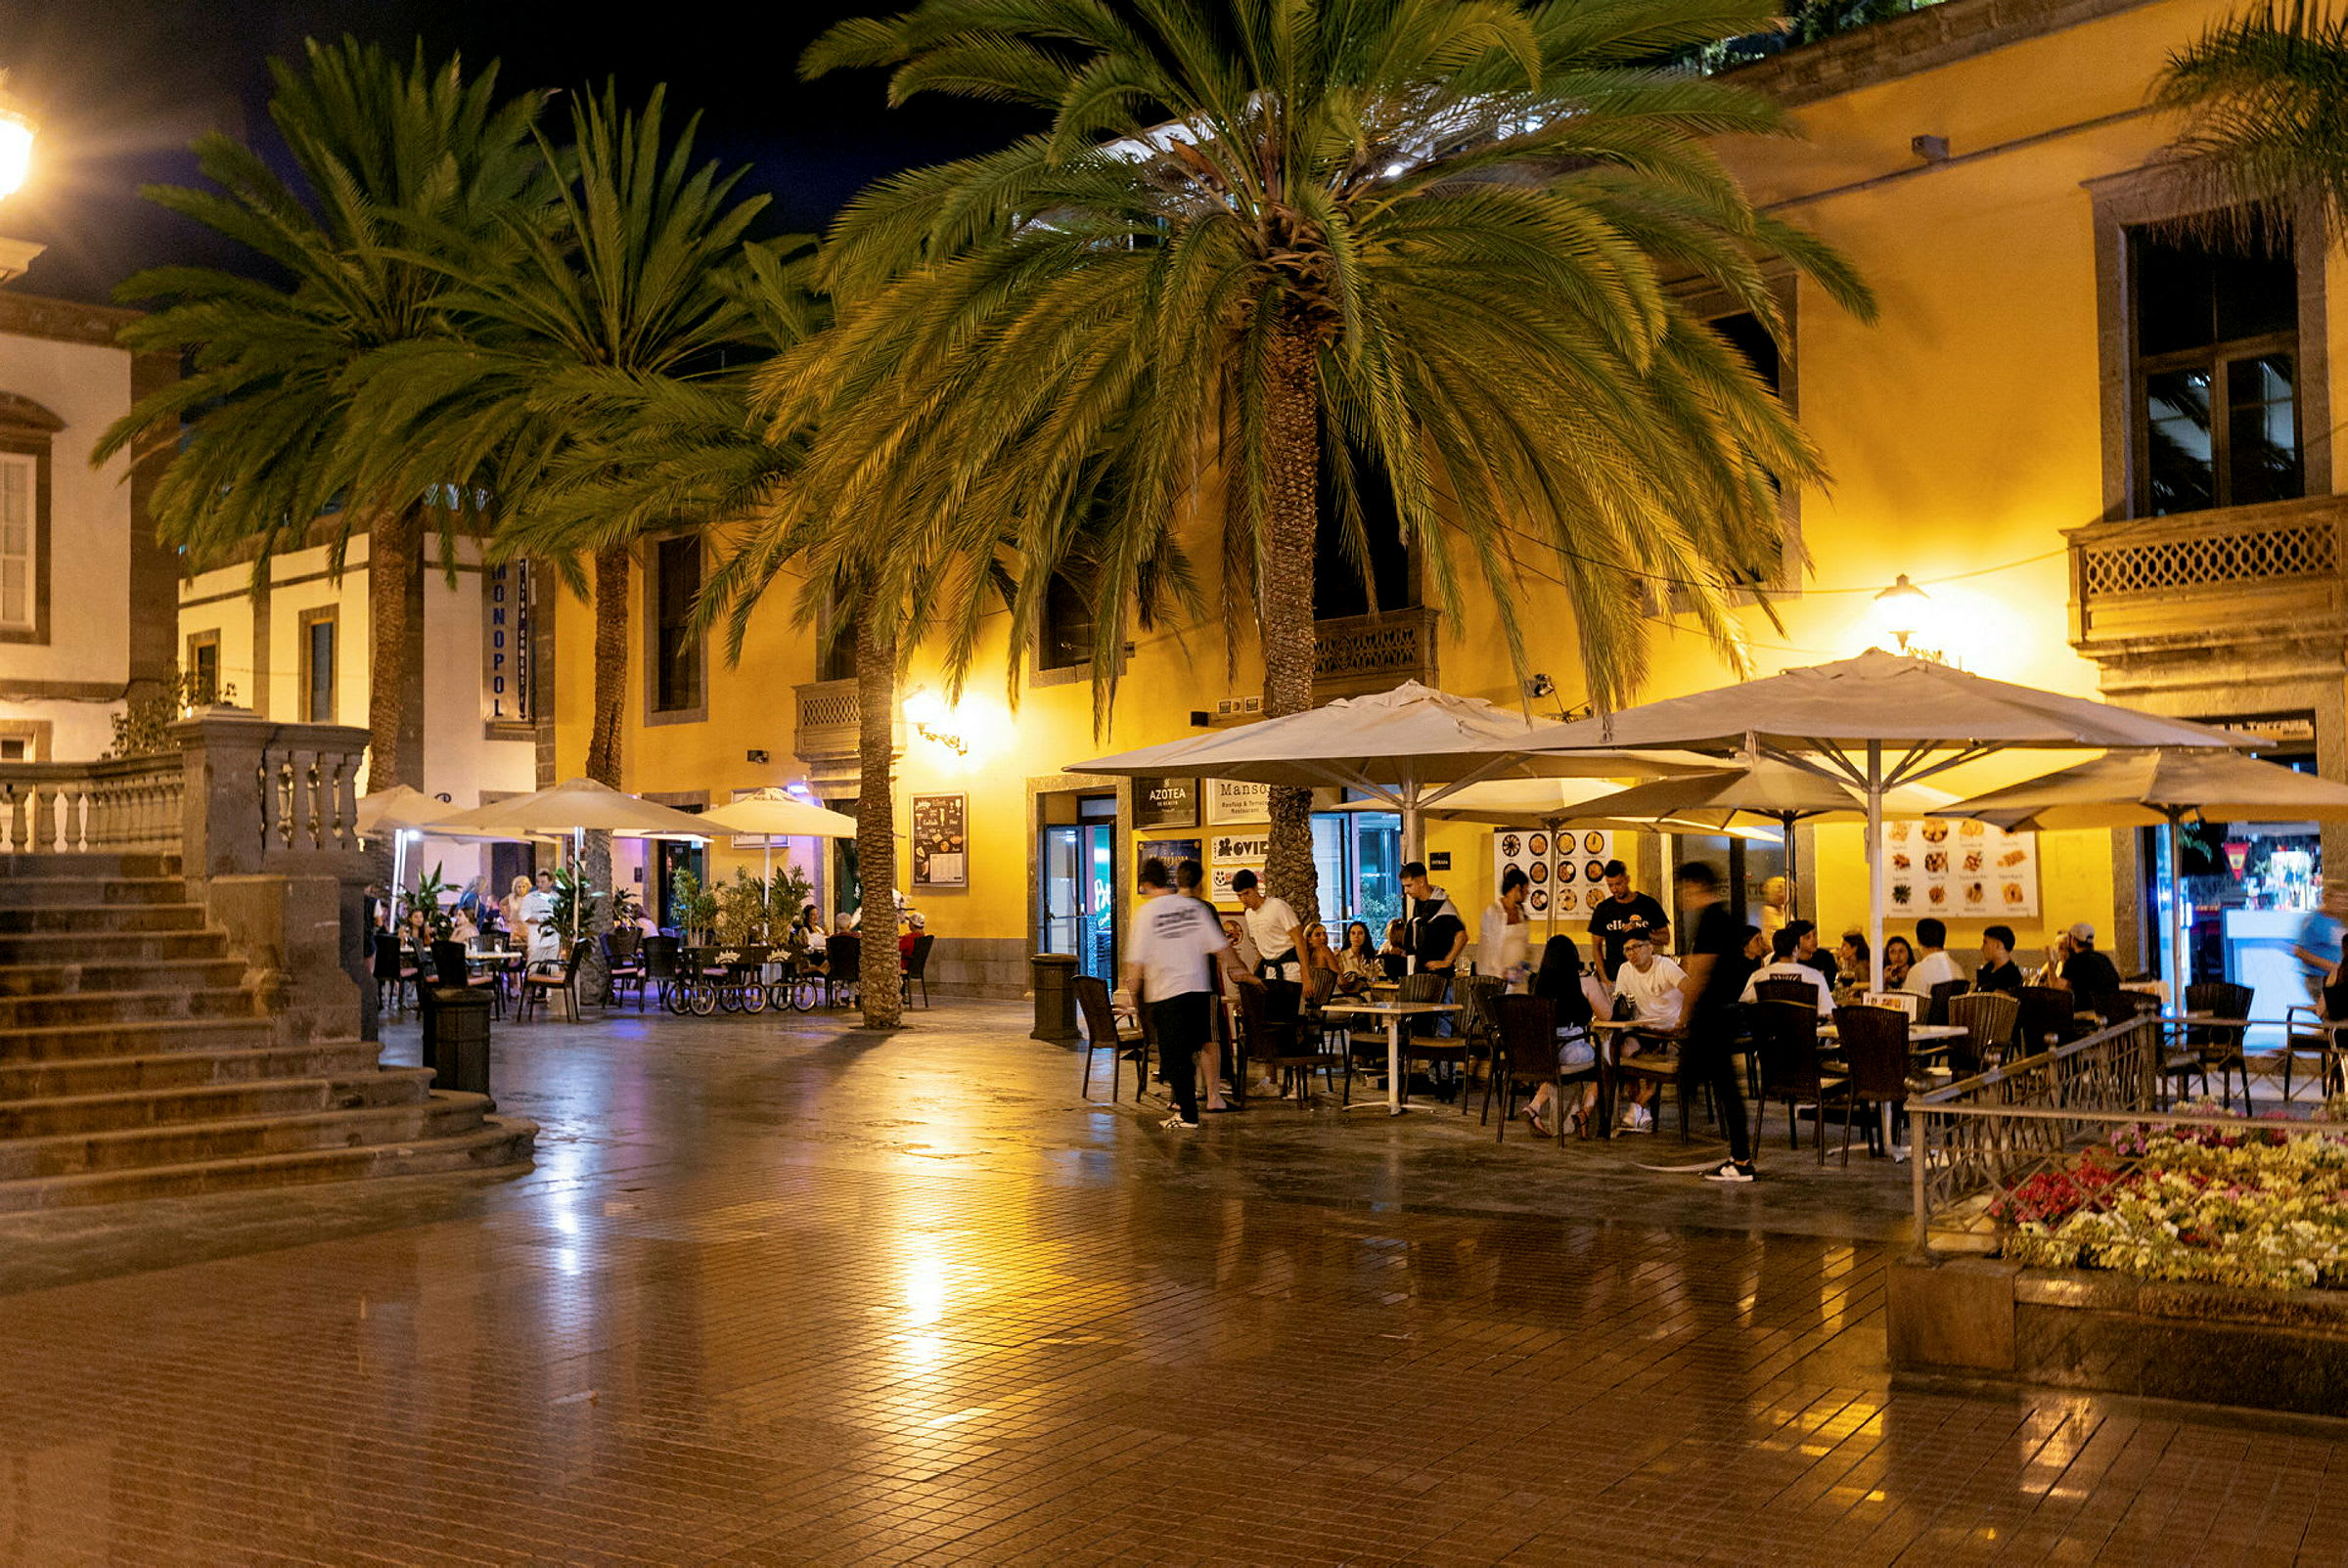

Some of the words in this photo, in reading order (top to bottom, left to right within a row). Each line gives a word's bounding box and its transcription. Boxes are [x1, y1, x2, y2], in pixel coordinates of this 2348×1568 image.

[492, 563, 506, 716] MONOPOL
[1150, 788, 1186, 801] AZOTEA
[1221, 784, 1267, 795] Manso
[1606, 919, 1649, 931] ellse
